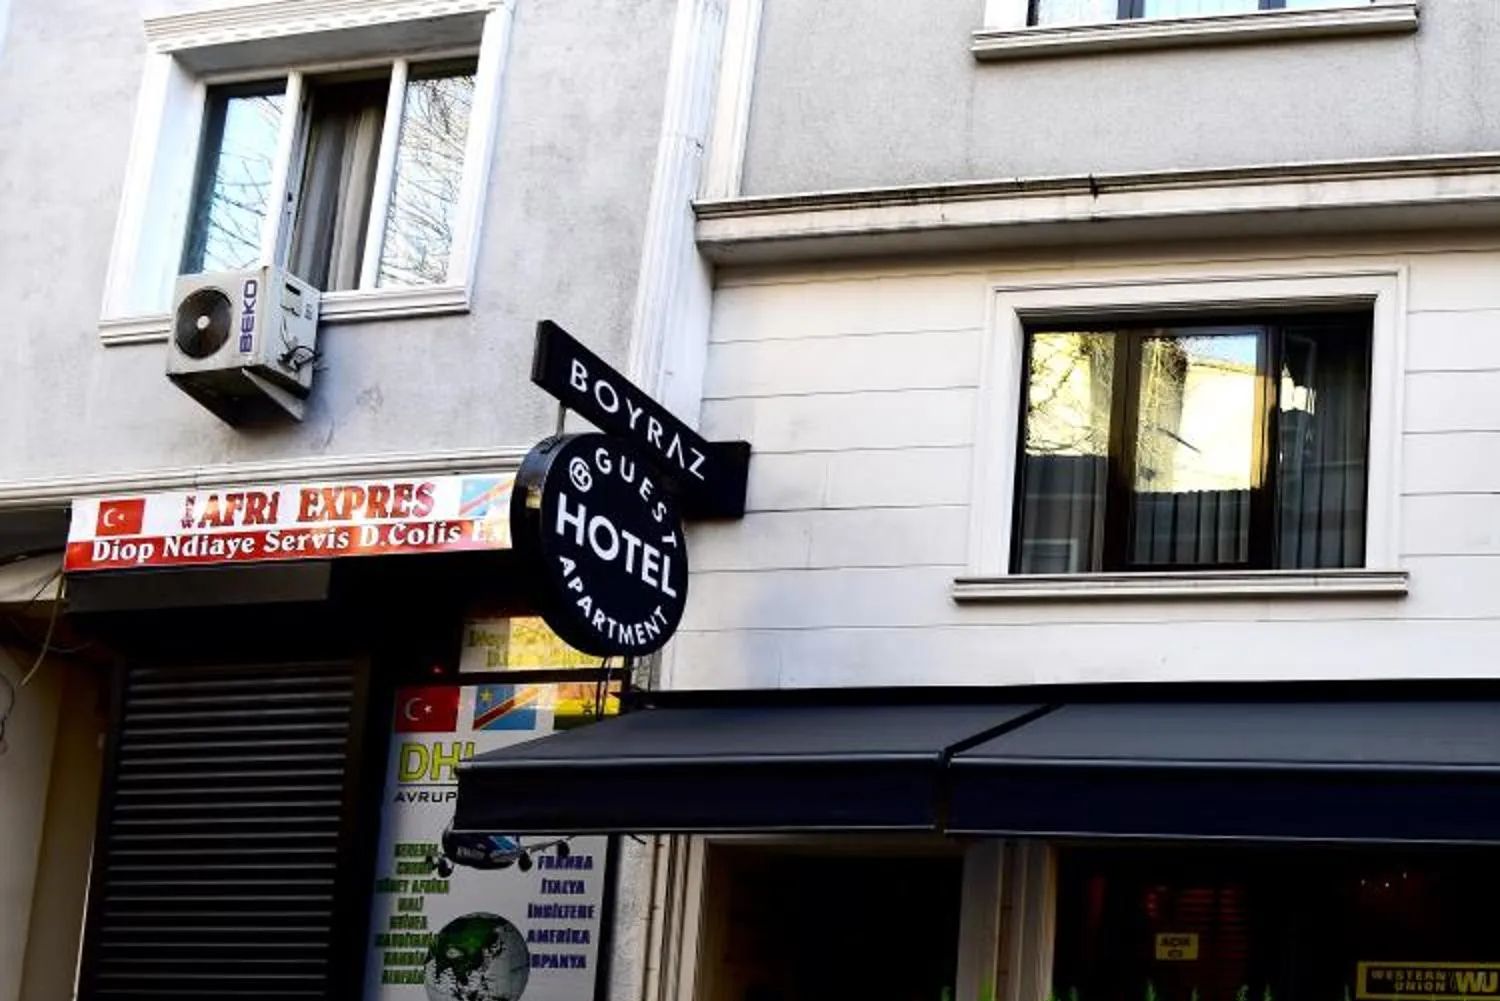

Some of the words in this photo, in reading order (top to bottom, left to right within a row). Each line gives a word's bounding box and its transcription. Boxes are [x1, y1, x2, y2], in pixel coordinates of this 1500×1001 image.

[239, 279, 258, 353] BEKO
[569, 357, 706, 481] BOYRAZ
[296, 482, 436, 522] EXPRES
[595, 447, 678, 549] GUEST
[92, 538, 154, 563] Diop
[163, 535, 255, 559] Ndiaye
[263, 524, 350, 552] Servis
[555, 492, 677, 598] HOTEL
[559, 555, 669, 646] APARTMENT
[394, 791, 457, 803] AVRUP
[1371, 968, 1447, 981] WESTERN
[1455, 970, 1499, 993] WU
[1394, 981, 1447, 992] UNION
